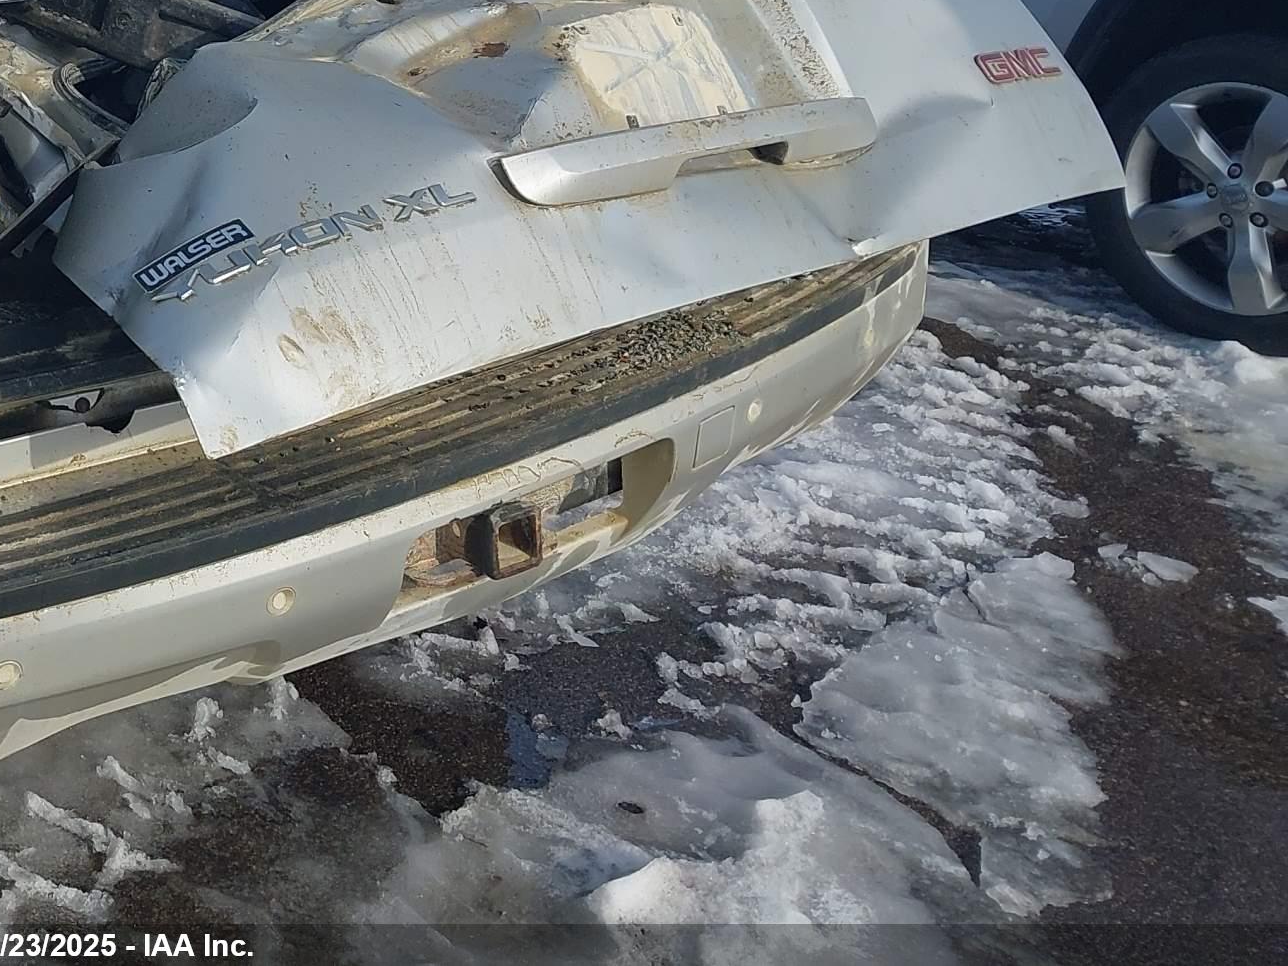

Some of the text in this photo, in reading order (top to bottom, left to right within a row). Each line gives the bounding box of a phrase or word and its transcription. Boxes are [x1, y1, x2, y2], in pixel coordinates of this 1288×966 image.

[974, 48, 1061, 84] GMC
[140, 223, 249, 287] WALSER
[151, 184, 477, 302] YUKON XL
